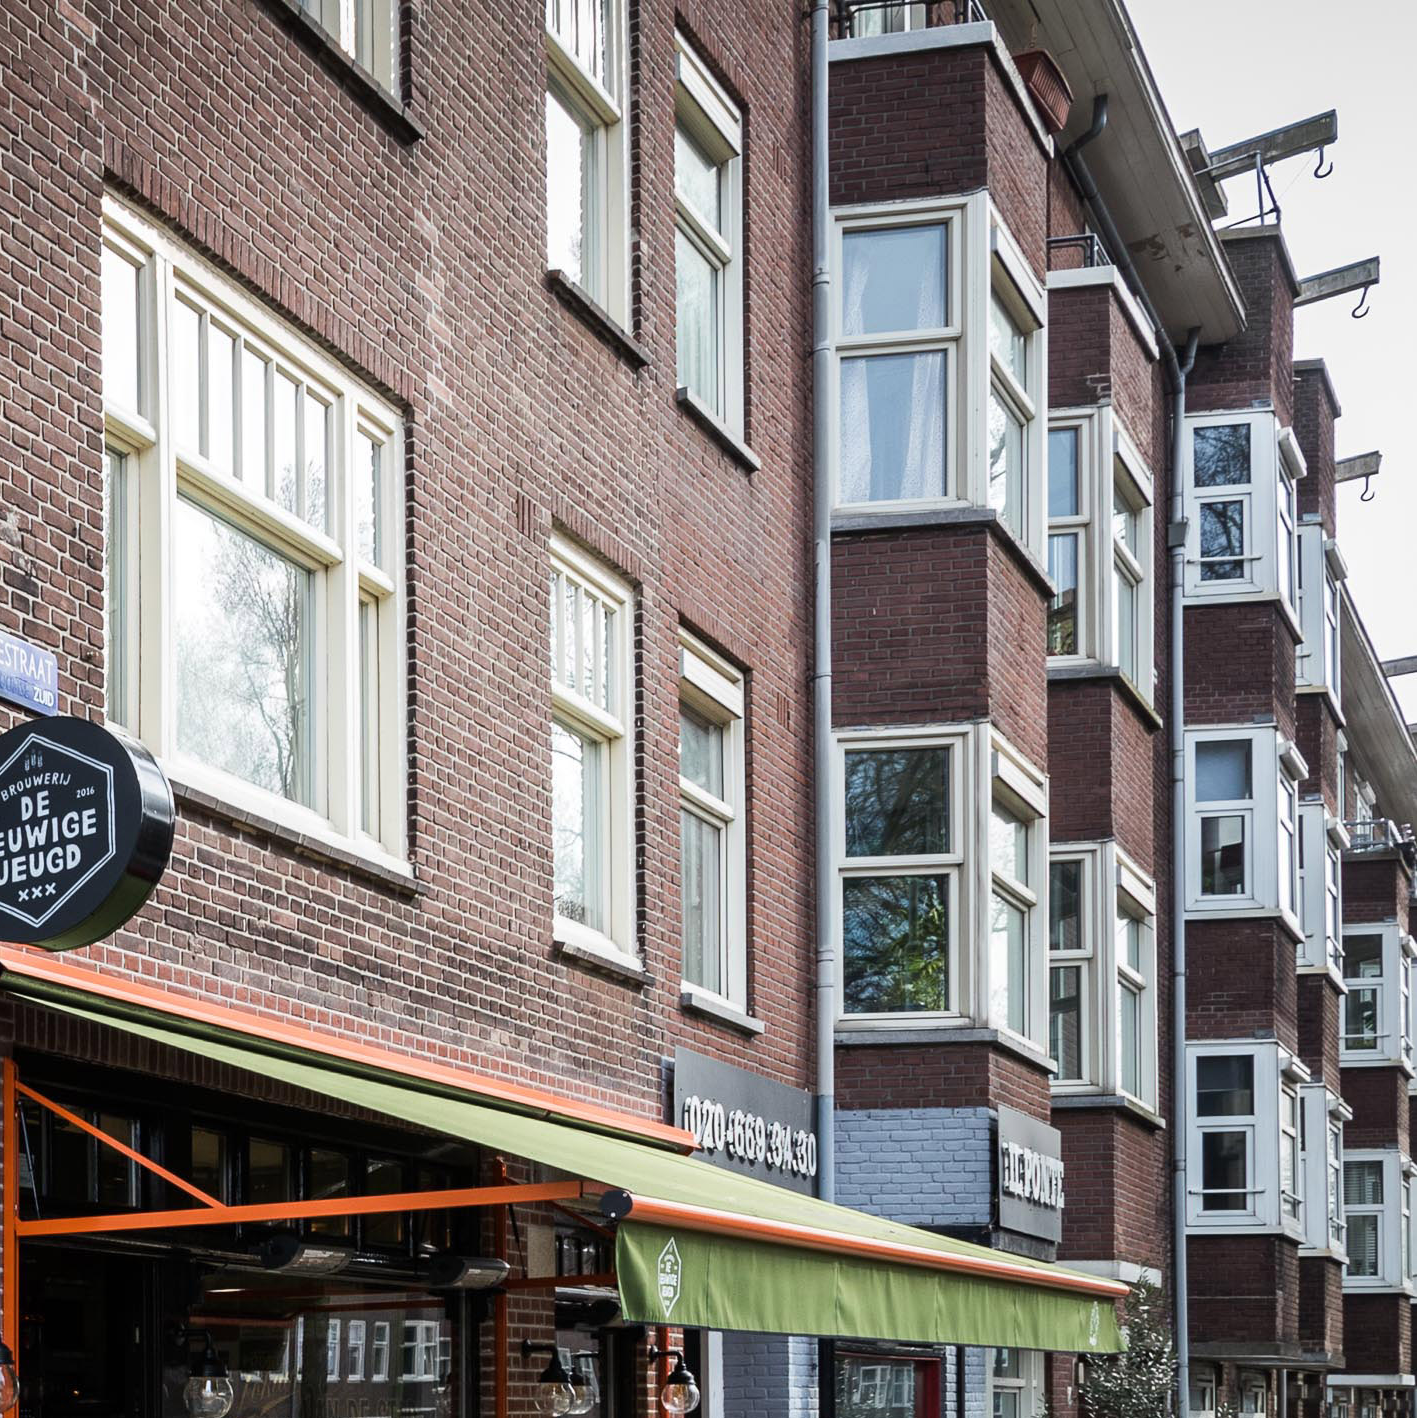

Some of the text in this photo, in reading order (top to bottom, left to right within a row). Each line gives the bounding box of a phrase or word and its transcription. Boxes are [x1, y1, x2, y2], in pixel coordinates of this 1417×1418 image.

[32, 686, 55, 708] ZUID
[0, 771, 72, 802] BROUWERIJ
[75, 786, 96, 799] 2016
[20, 790, 51, 822] DE
